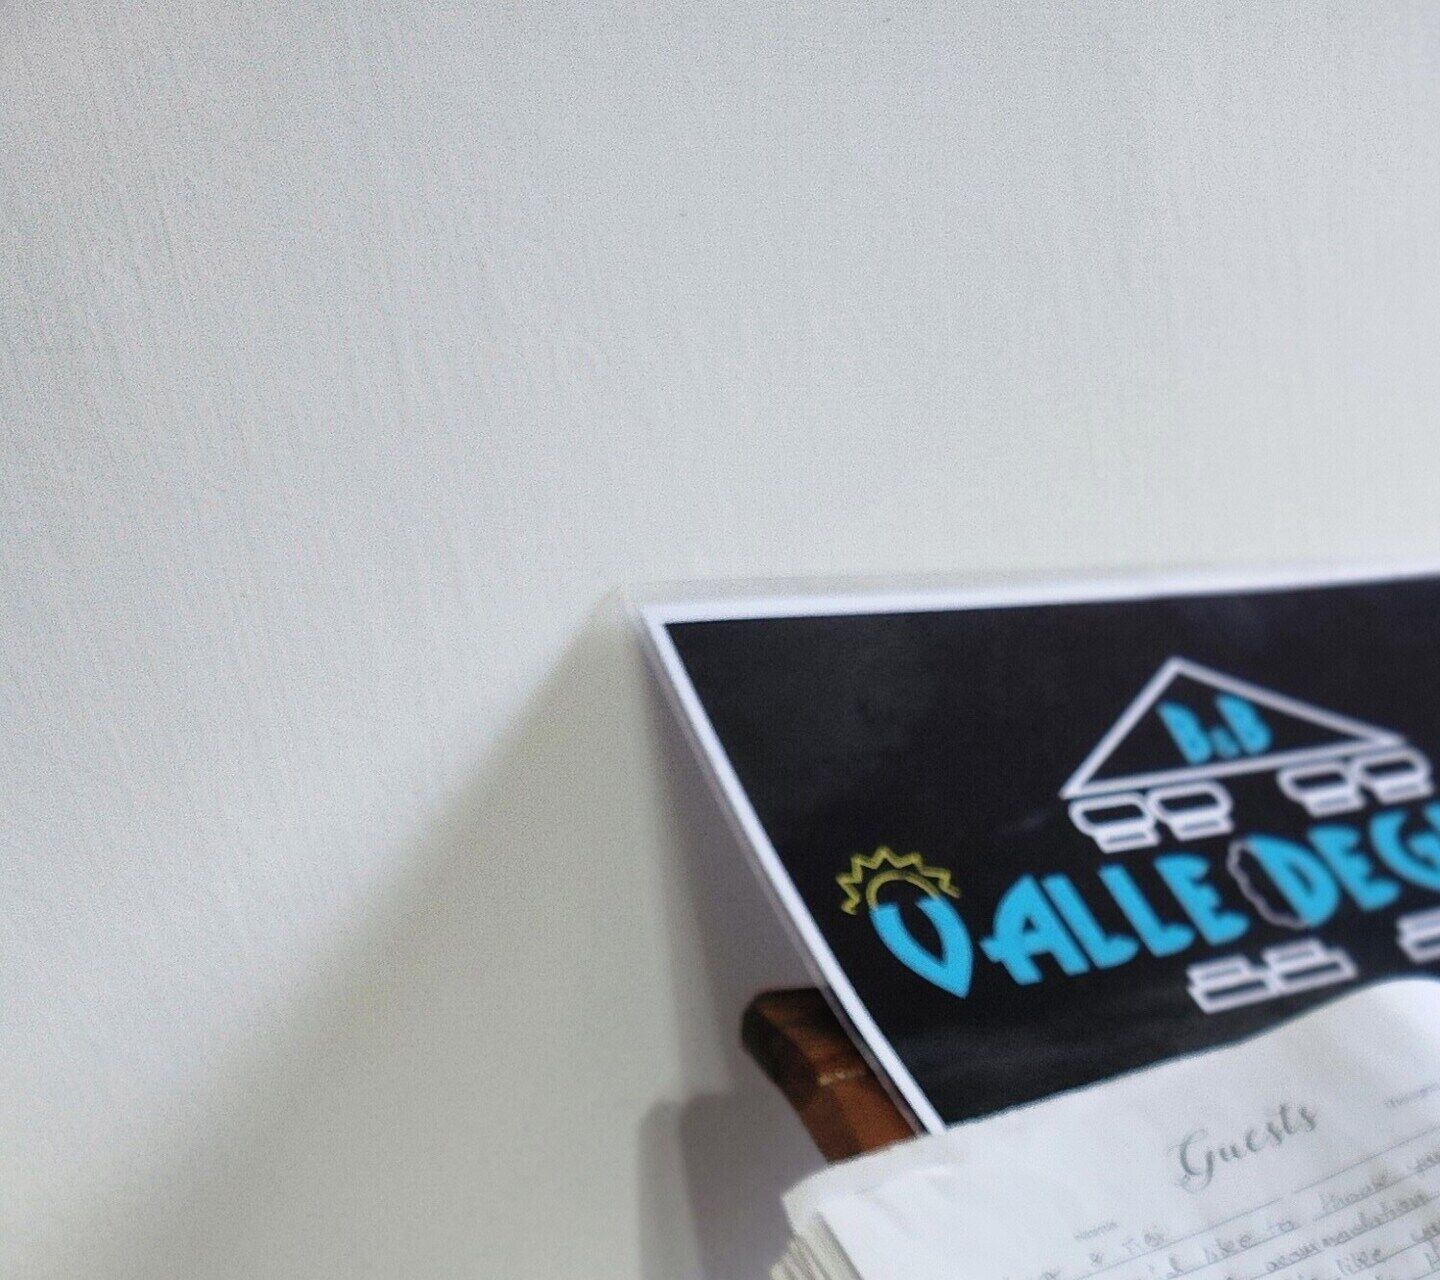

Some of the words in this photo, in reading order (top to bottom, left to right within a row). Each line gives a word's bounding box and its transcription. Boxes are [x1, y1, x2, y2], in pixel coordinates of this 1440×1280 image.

[1156, 693, 1273, 764] B&B
[867, 852, 1250, 999] VALLE
[1171, 1102, 1319, 1193] Guests
